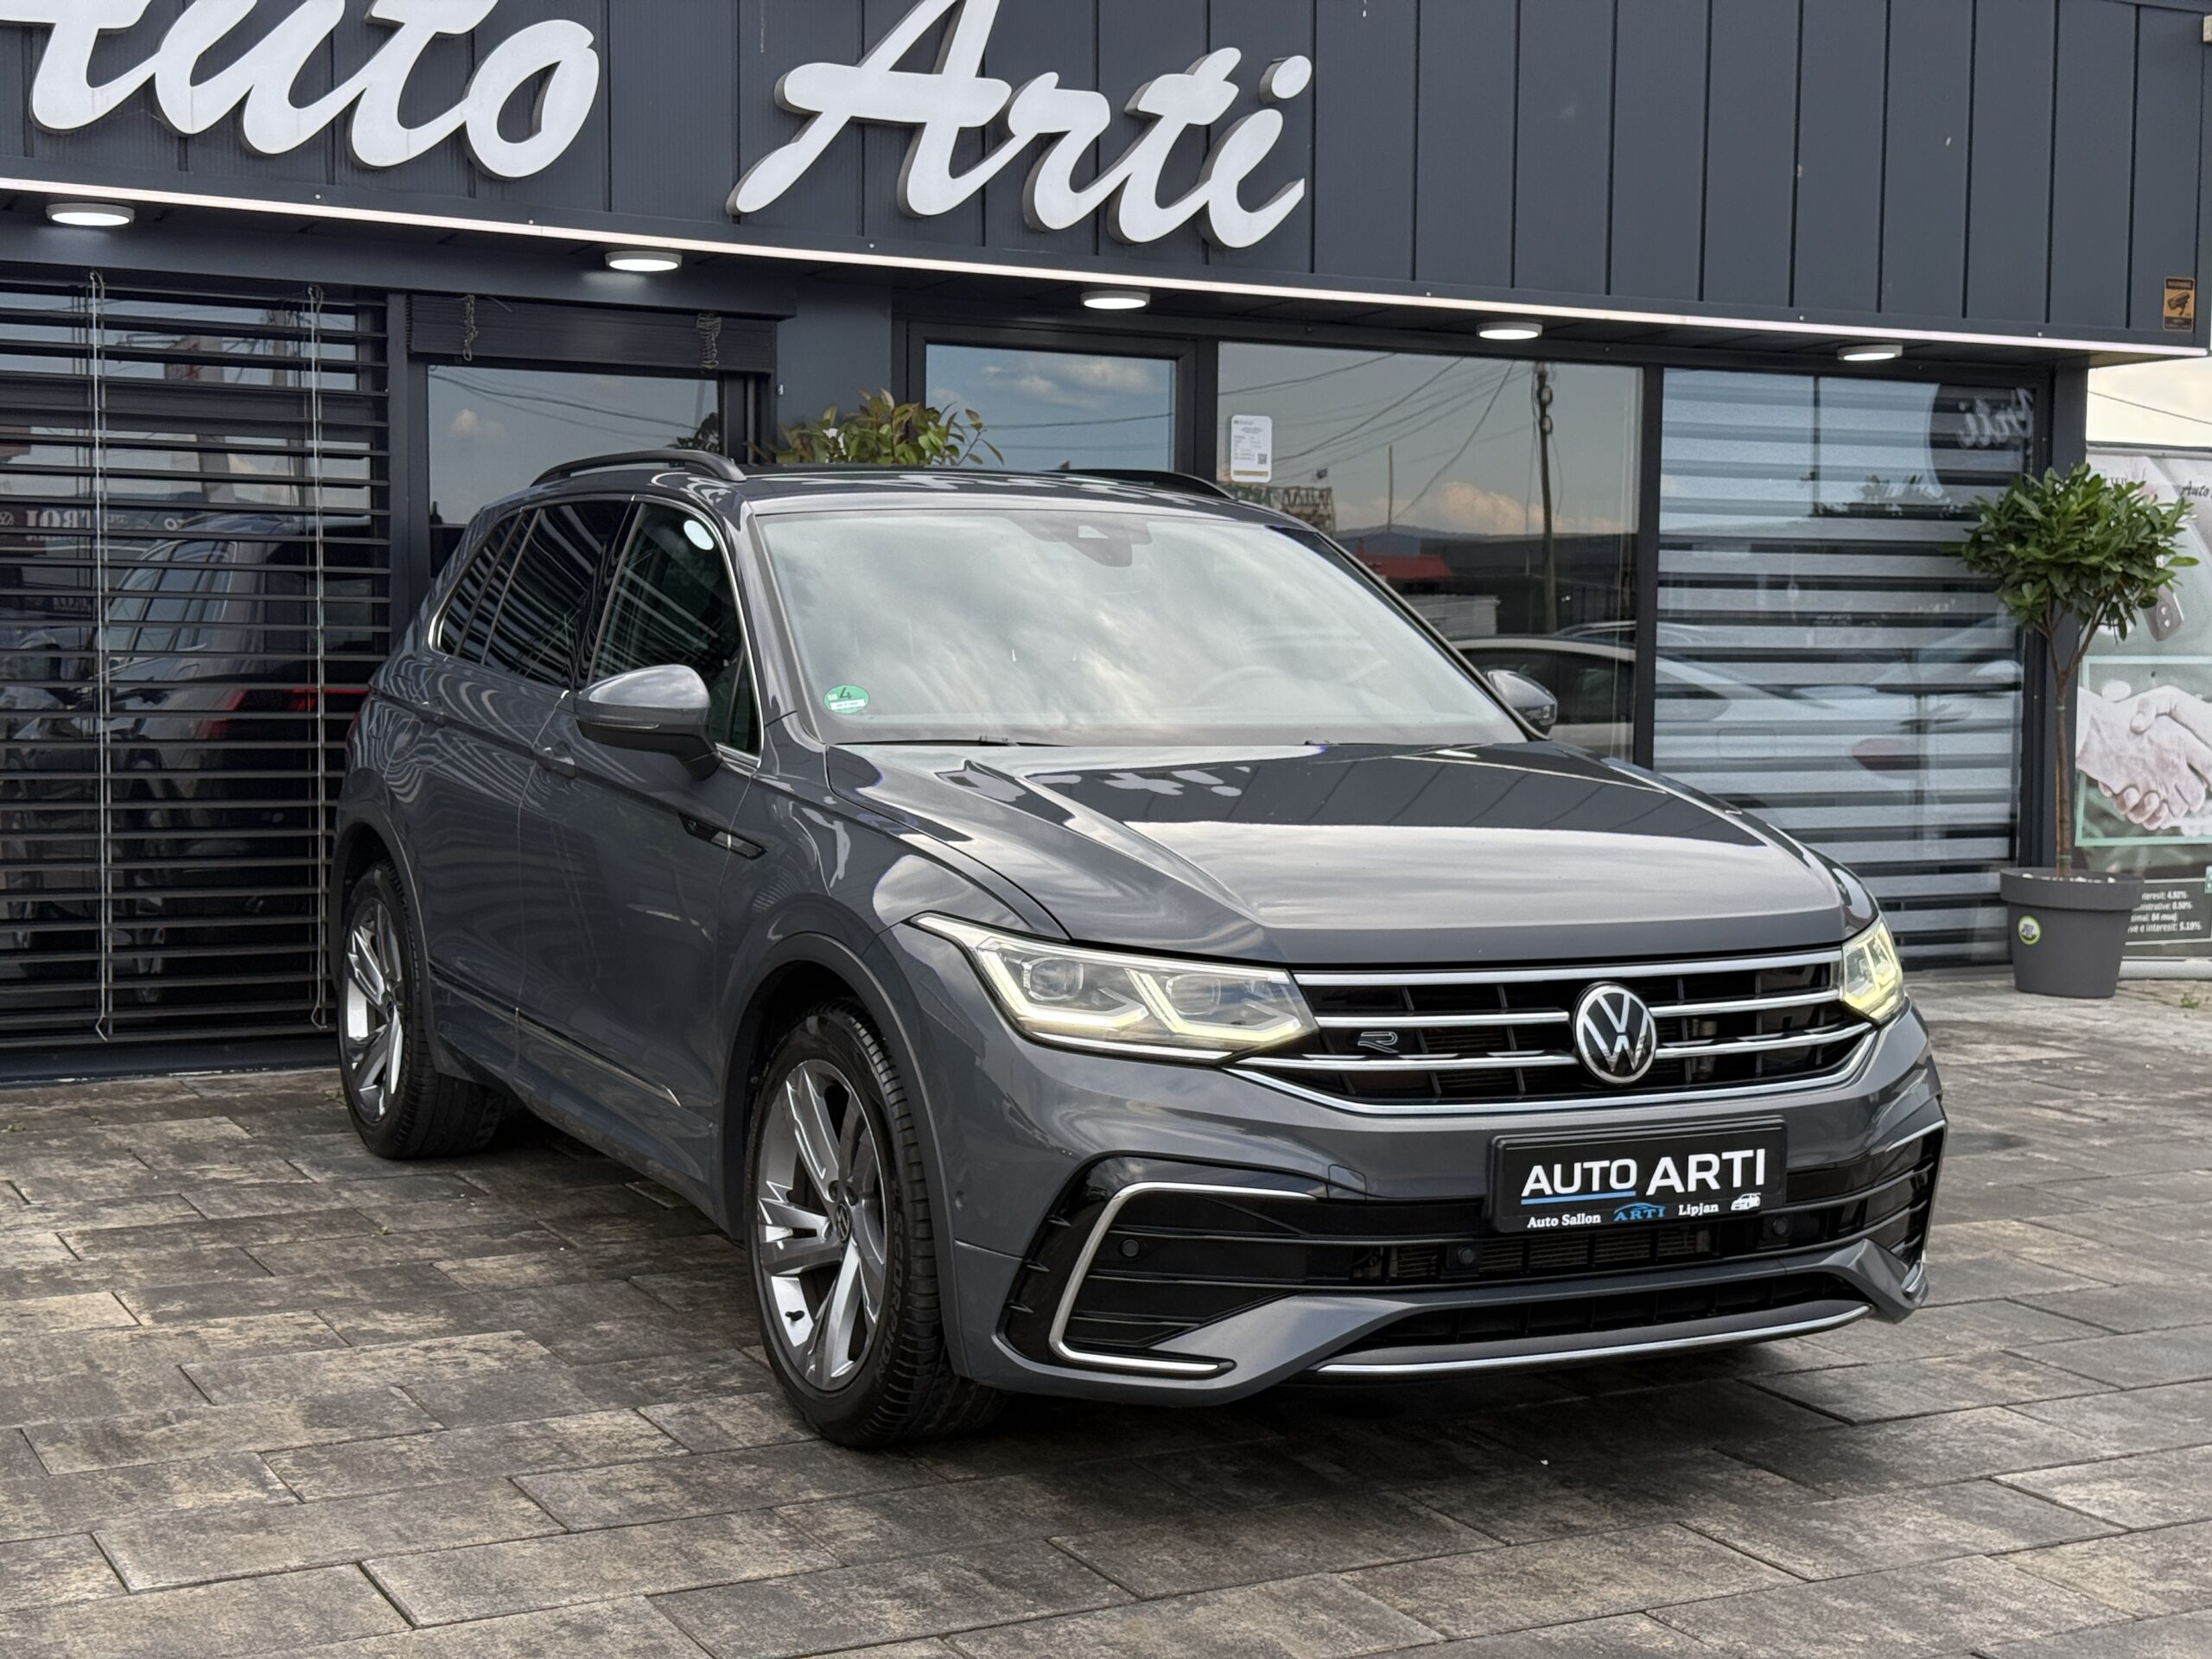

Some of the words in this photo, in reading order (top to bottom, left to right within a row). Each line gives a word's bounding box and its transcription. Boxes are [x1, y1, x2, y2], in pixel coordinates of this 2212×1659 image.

[728, 0, 1313, 249] Arti
[2181, 481, 2209, 498] Auto
[1521, 1159, 1637, 1197] AUTO
[1645, 1148, 1765, 1196] ARTI
[1527, 1216, 1559, 1229] Auto
[1561, 1213, 1601, 1226] Sallon
[1613, 1207, 1666, 1222] ARTI
[1678, 1203, 1719, 1217] Lipjan
